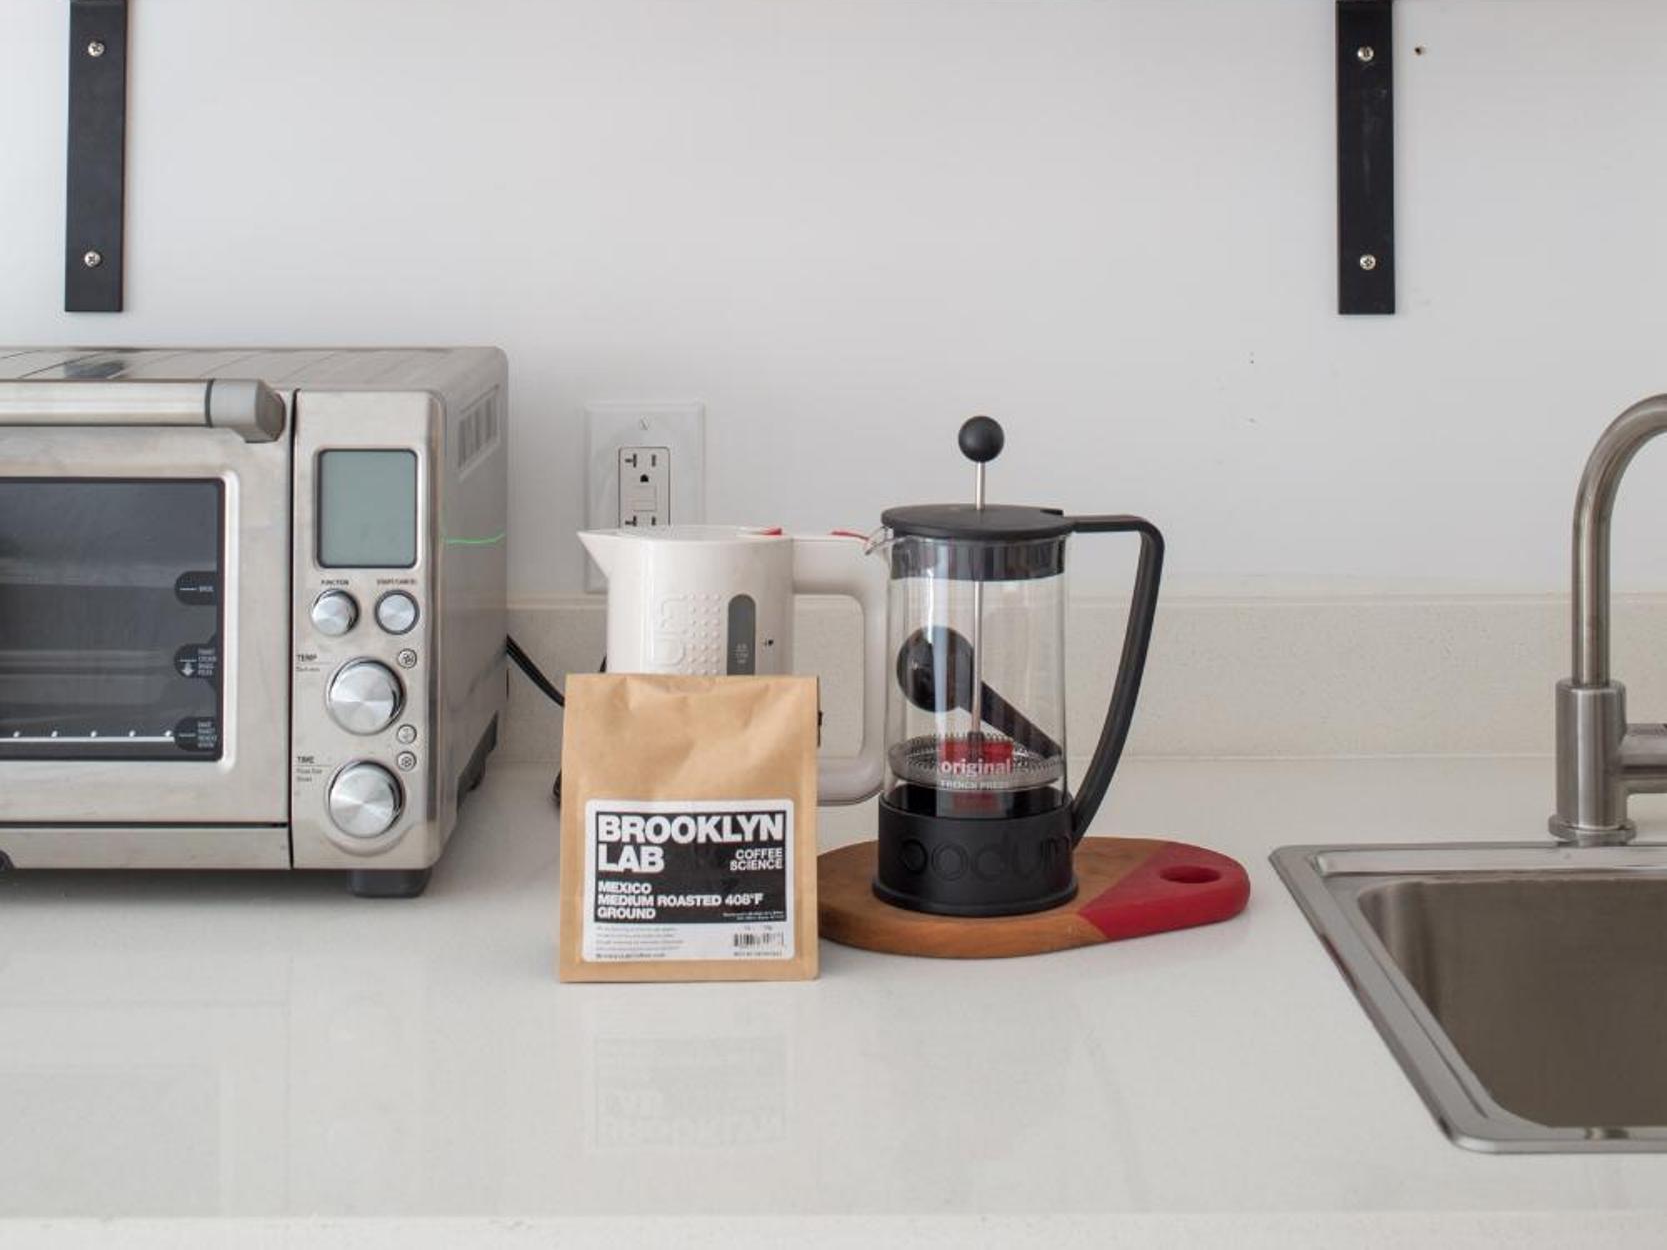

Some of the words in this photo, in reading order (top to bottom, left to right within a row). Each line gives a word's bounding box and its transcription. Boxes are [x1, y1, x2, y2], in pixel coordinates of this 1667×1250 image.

[941, 758, 1012, 777] original
[597, 814, 784, 844] BROOKLYN
[597, 845, 665, 873] LAB
[735, 849, 783, 860] COFFEE
[730, 860, 783, 871] SCIENCE
[597, 881, 652, 895] MEXICO
[597, 894, 654, 907] MEDIUM
[657, 894, 722, 907] ROASTED
[597, 907, 656, 920] GROUND
